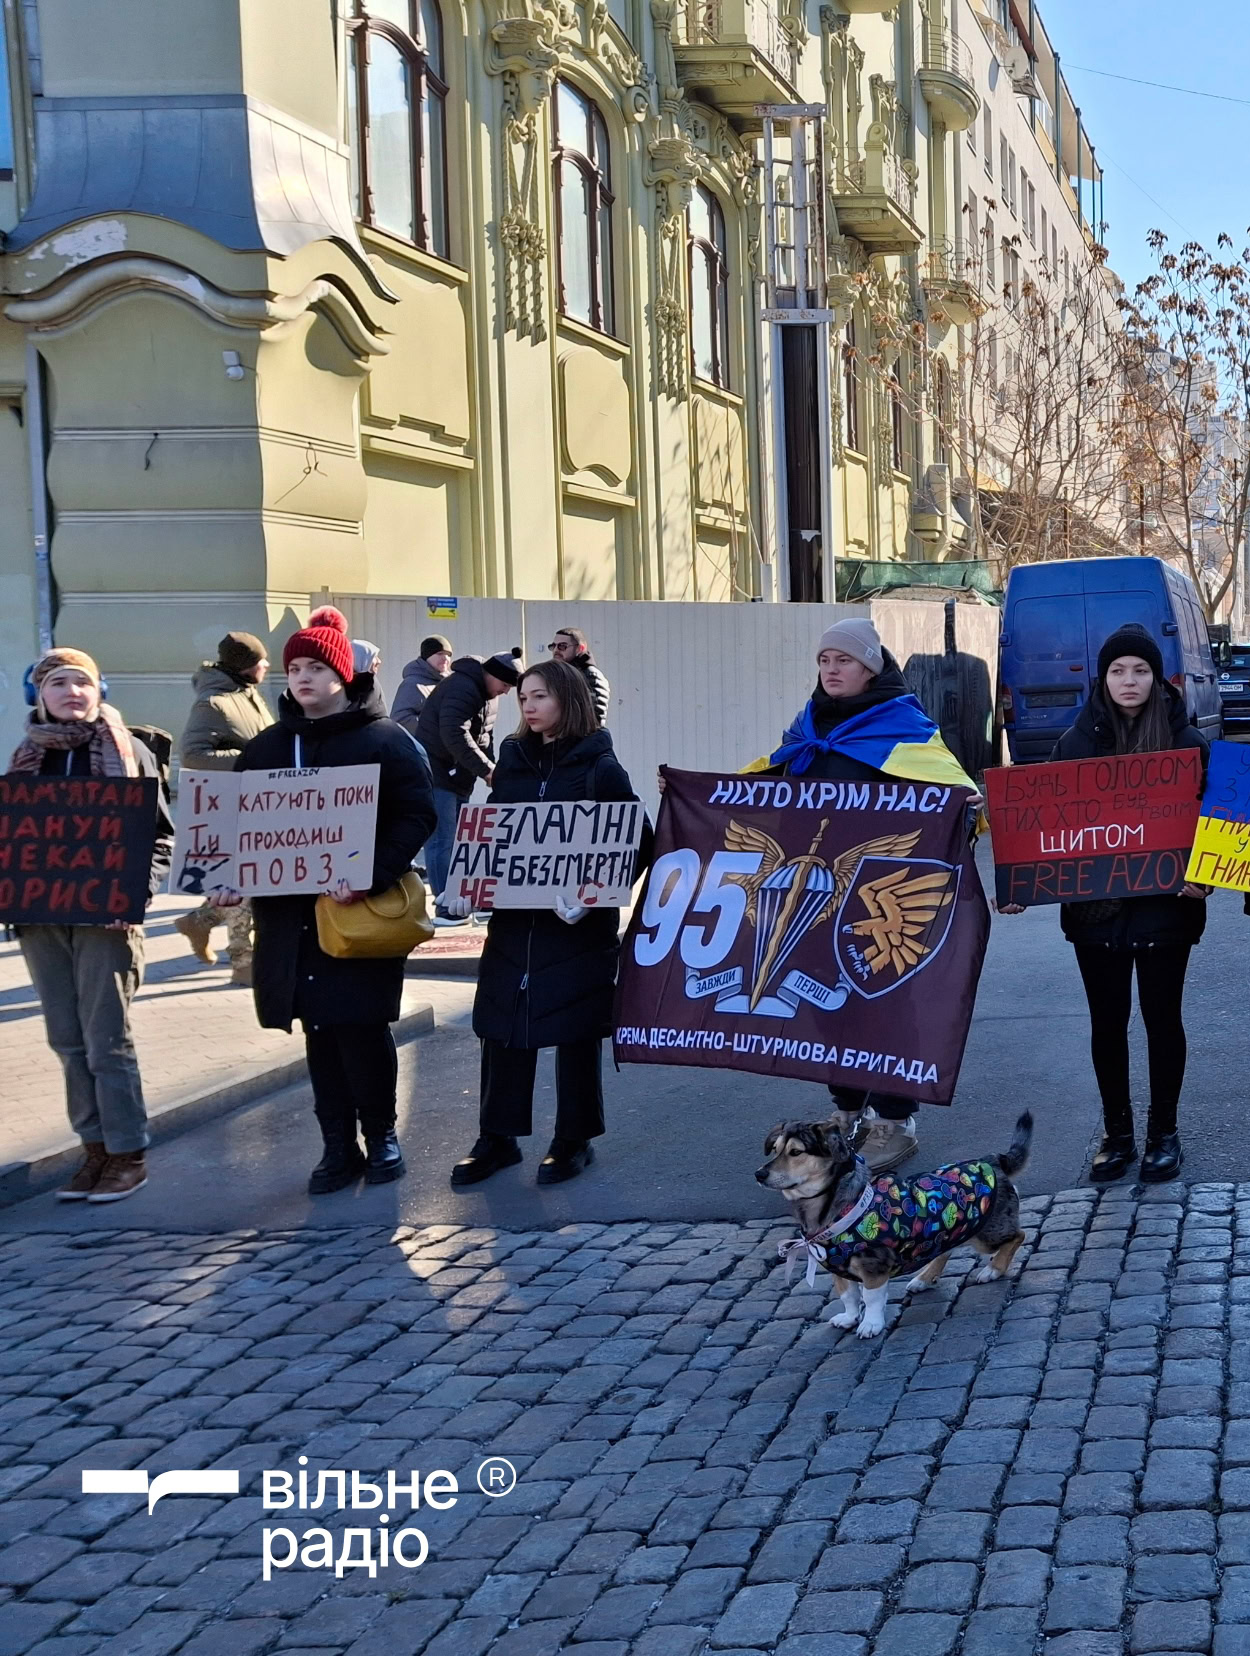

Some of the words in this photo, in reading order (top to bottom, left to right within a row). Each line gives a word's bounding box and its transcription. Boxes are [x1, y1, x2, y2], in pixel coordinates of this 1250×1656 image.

[268, 768, 320, 780] #FREEAZOV
[1077, 755, 1197, 794] ГОЛОСОМ
[239, 788, 325, 812] КАТУЮТЬ
[334, 784, 374, 808] ПОКИ
[708, 780, 792, 808] НІХТО
[796, 782, 870, 810] КРІМ
[874, 784, 951, 813] НАС!
[1219, 778, 1238, 803] З
[457, 804, 637, 845] НЕЗЛАМНІ
[996, 803, 1044, 833] ТИХ
[1051, 798, 1101, 829] ХТО
[1113, 792, 1149, 810] БУВ
[239, 825, 343, 853] ПРОХОДИШ
[1040, 823, 1144, 853] ЩИТОМ
[1234, 839, 1249, 854] У
[449, 843, 509, 878] АЛЕ
[1010, 860, 1095, 901] FREE
[634, 848, 764, 969] 95
[695, 970, 737, 994] ЗАВЖДИ
[794, 975, 831, 1003] ПЕРШІ
[650, 1027, 838, 1065] ДЕСАНТНО-ШТУРМОВА
[840, 1049, 939, 1084] БРИГАДА
